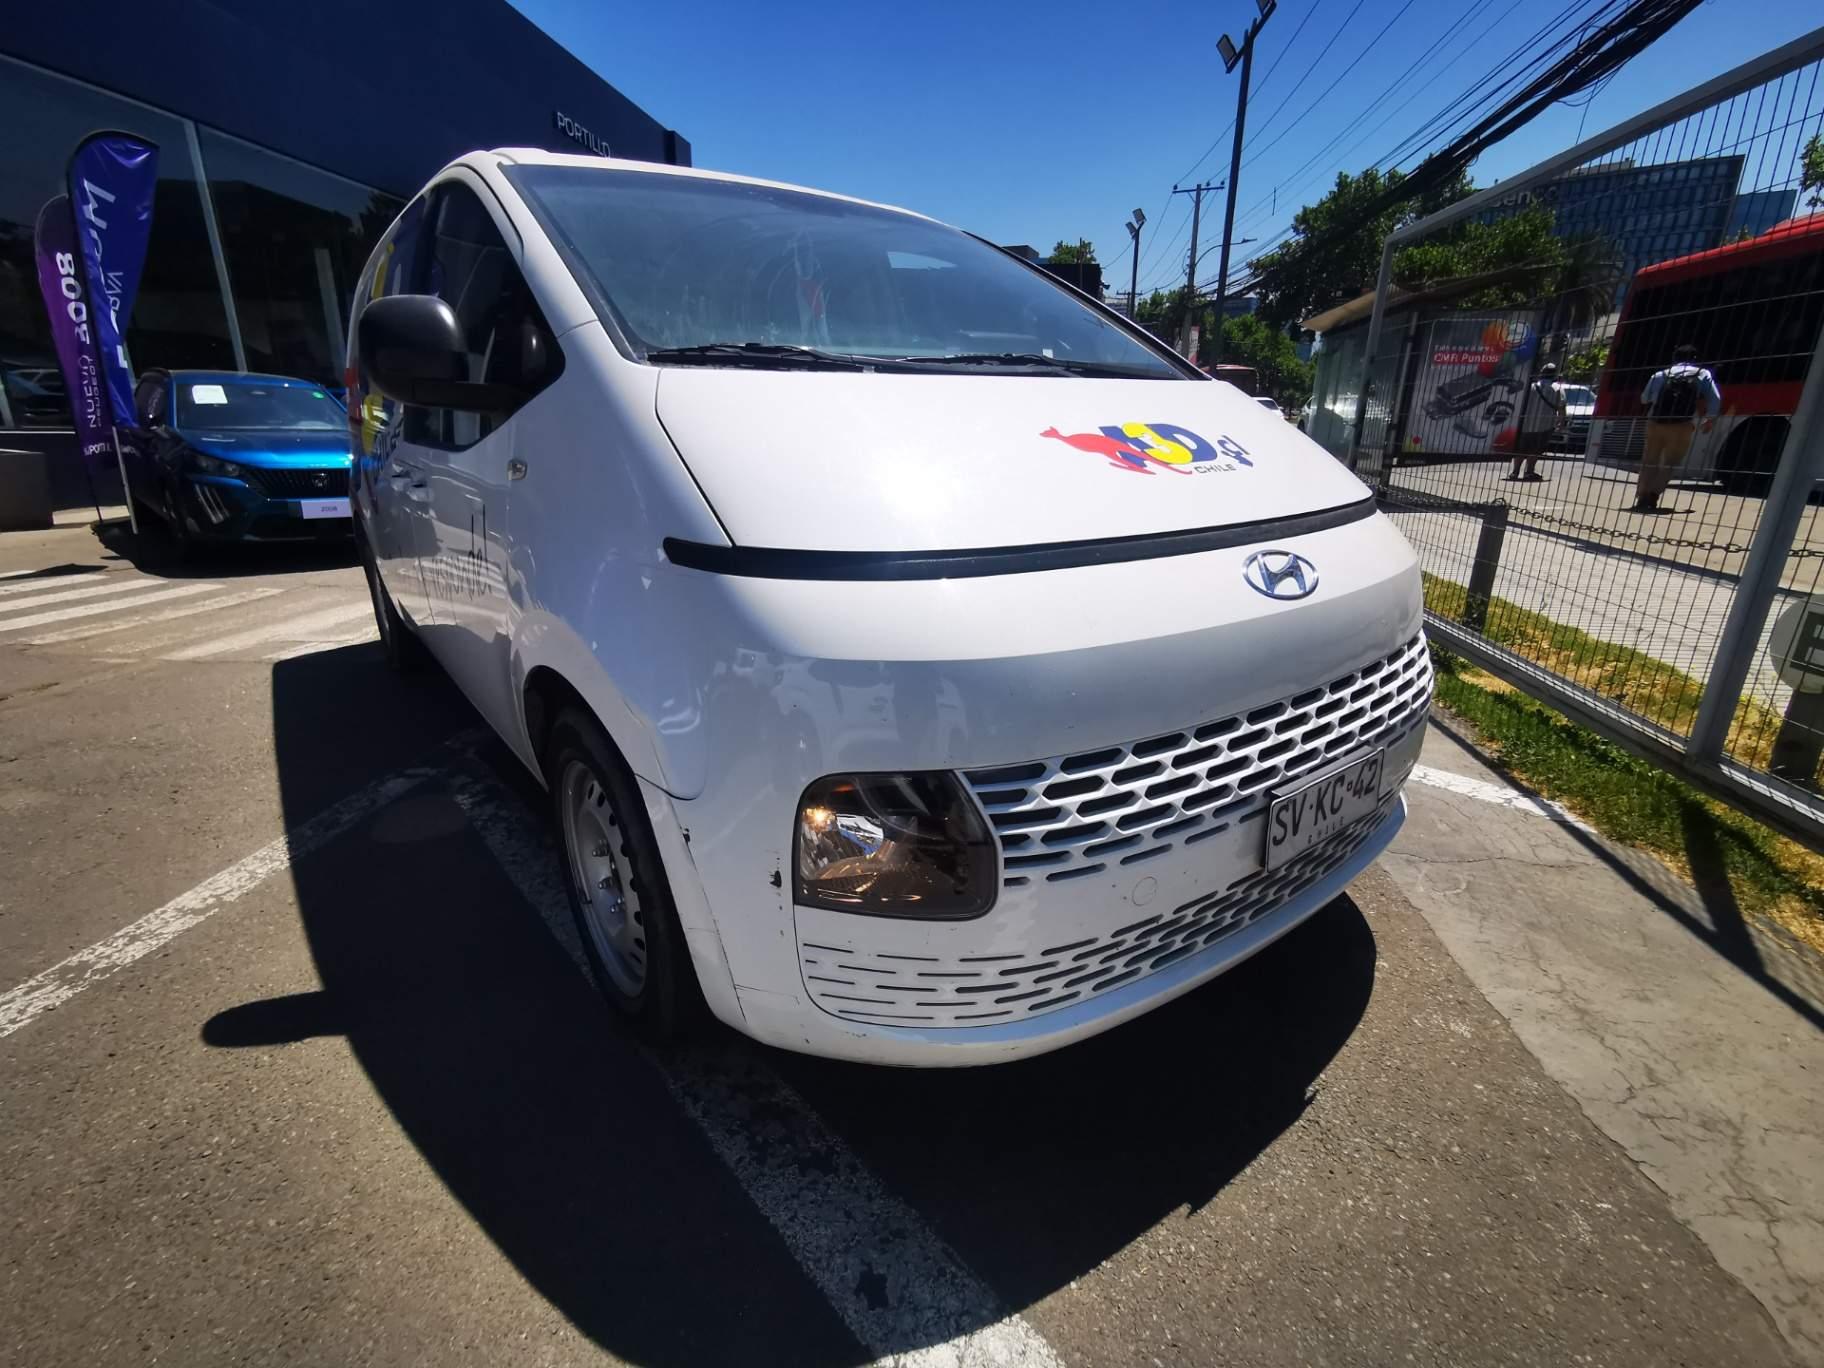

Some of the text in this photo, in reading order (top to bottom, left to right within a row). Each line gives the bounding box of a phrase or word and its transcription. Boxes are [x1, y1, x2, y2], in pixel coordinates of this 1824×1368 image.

[556, 111, 611, 158] PORTILLO
[55, 251, 91, 345] 3008
[1194, 464, 1237, 474] CHILE
